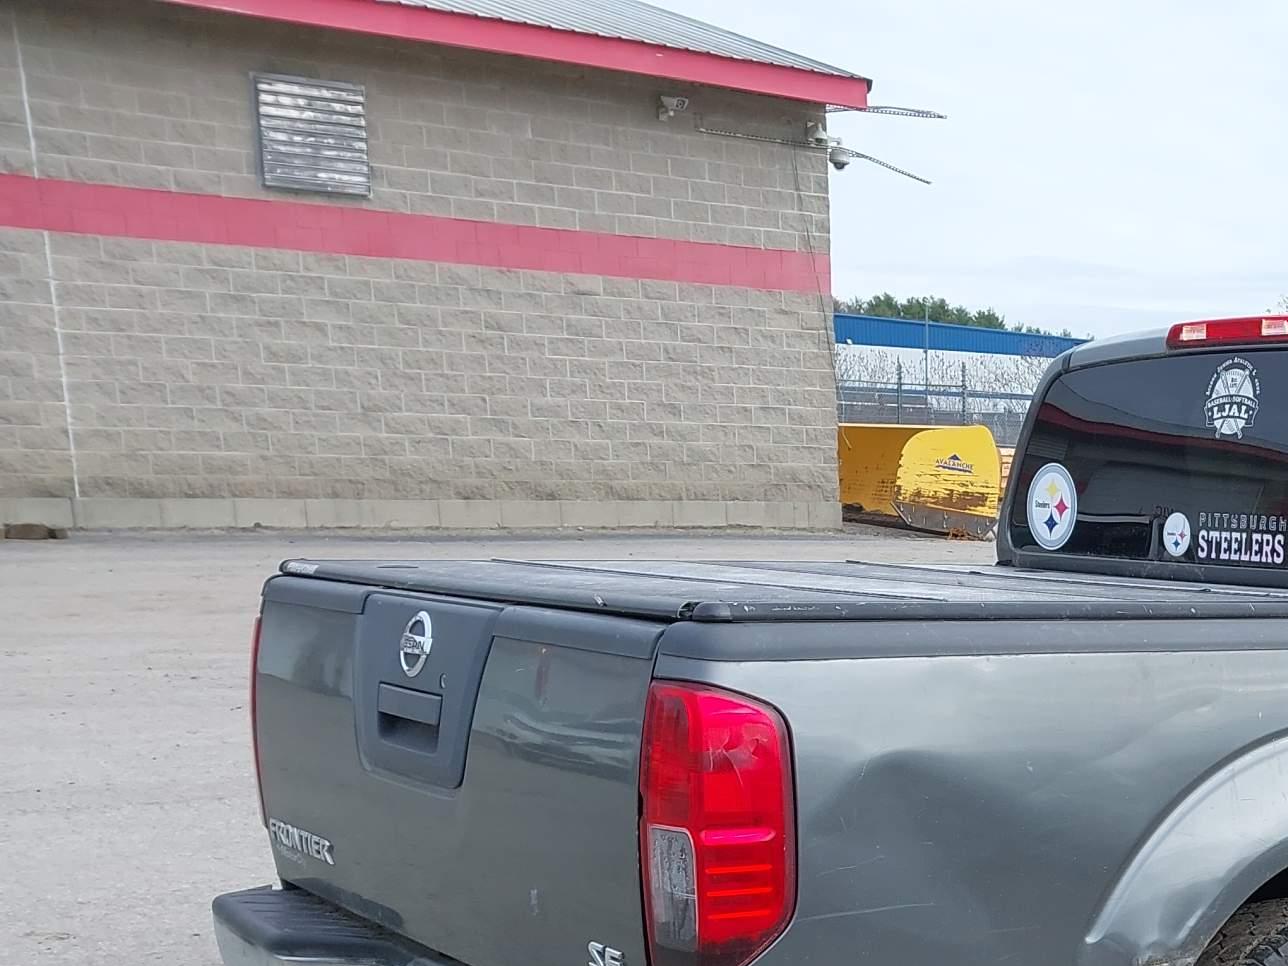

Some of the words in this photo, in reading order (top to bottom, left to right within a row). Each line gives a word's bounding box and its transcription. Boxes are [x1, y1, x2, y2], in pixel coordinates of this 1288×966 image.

[1212, 404, 1249, 419] LJAL
[935, 458, 974, 470] AVALANCHE
[1199, 511, 1288, 531] PITTSBURGH
[1197, 529, 1284, 564] STEELERS
[269, 817, 335, 865] FRONTIER
